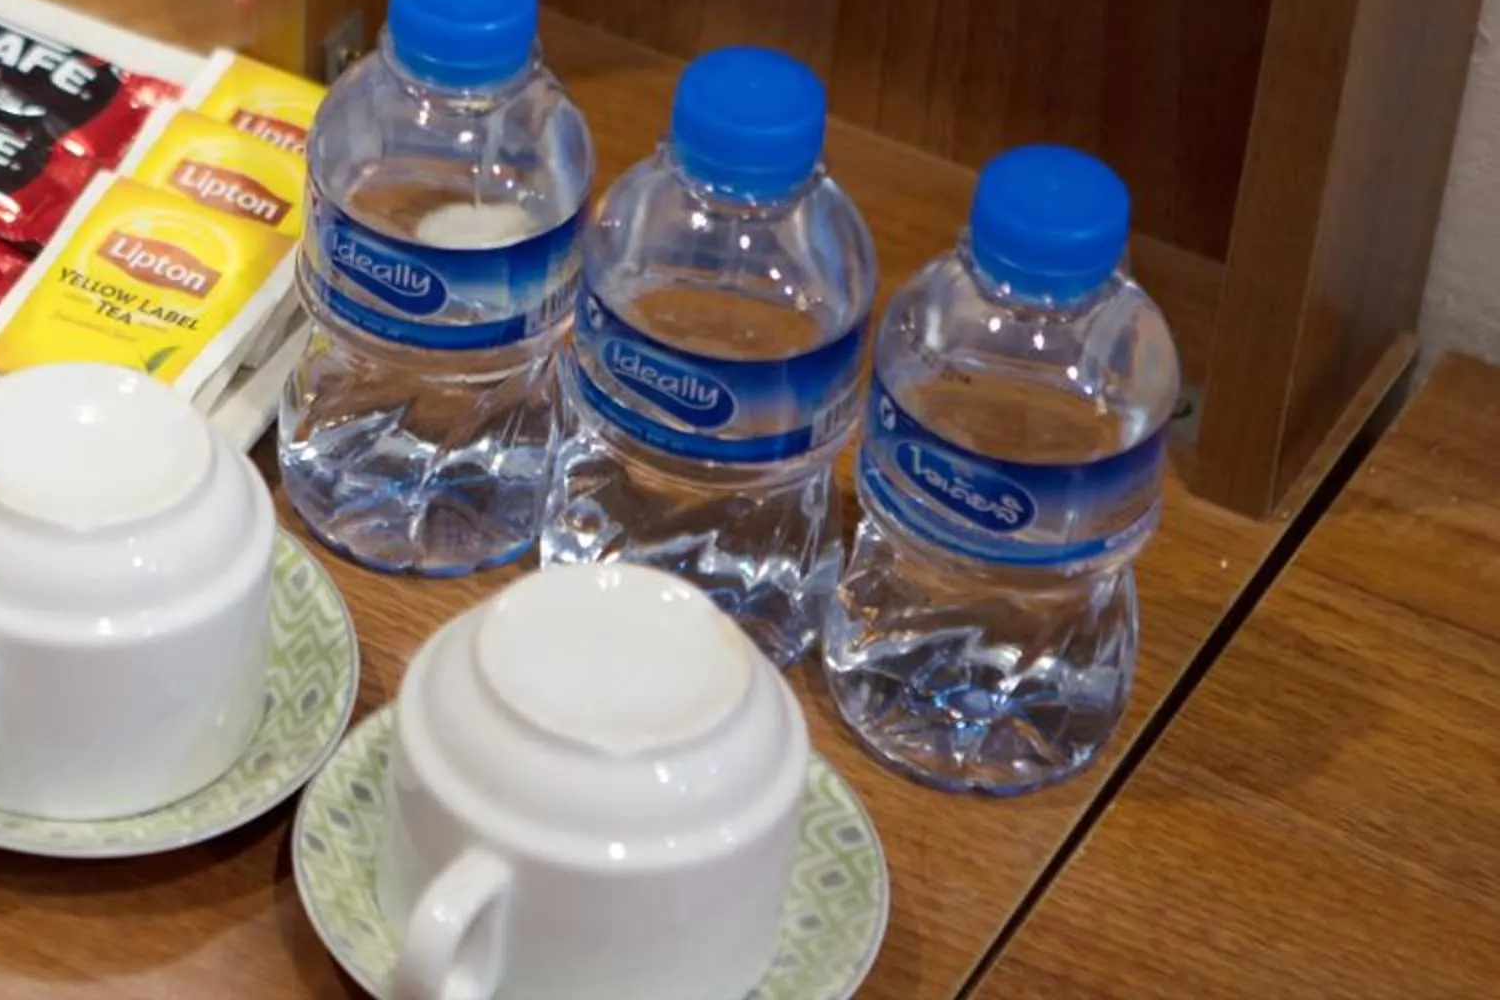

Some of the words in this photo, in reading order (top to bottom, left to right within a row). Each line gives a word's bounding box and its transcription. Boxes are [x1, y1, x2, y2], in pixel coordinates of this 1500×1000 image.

[237, 114, 306, 156] Lipto
[180, 161, 279, 221] Lipton
[109, 234, 206, 292] Lipton
[333, 234, 432, 296] Ideally
[59, 267, 138, 305] YELLOW
[139, 298, 200, 332] LABEL
[96, 300, 132, 326] TEA
[612, 343, 720, 410] Ideally
